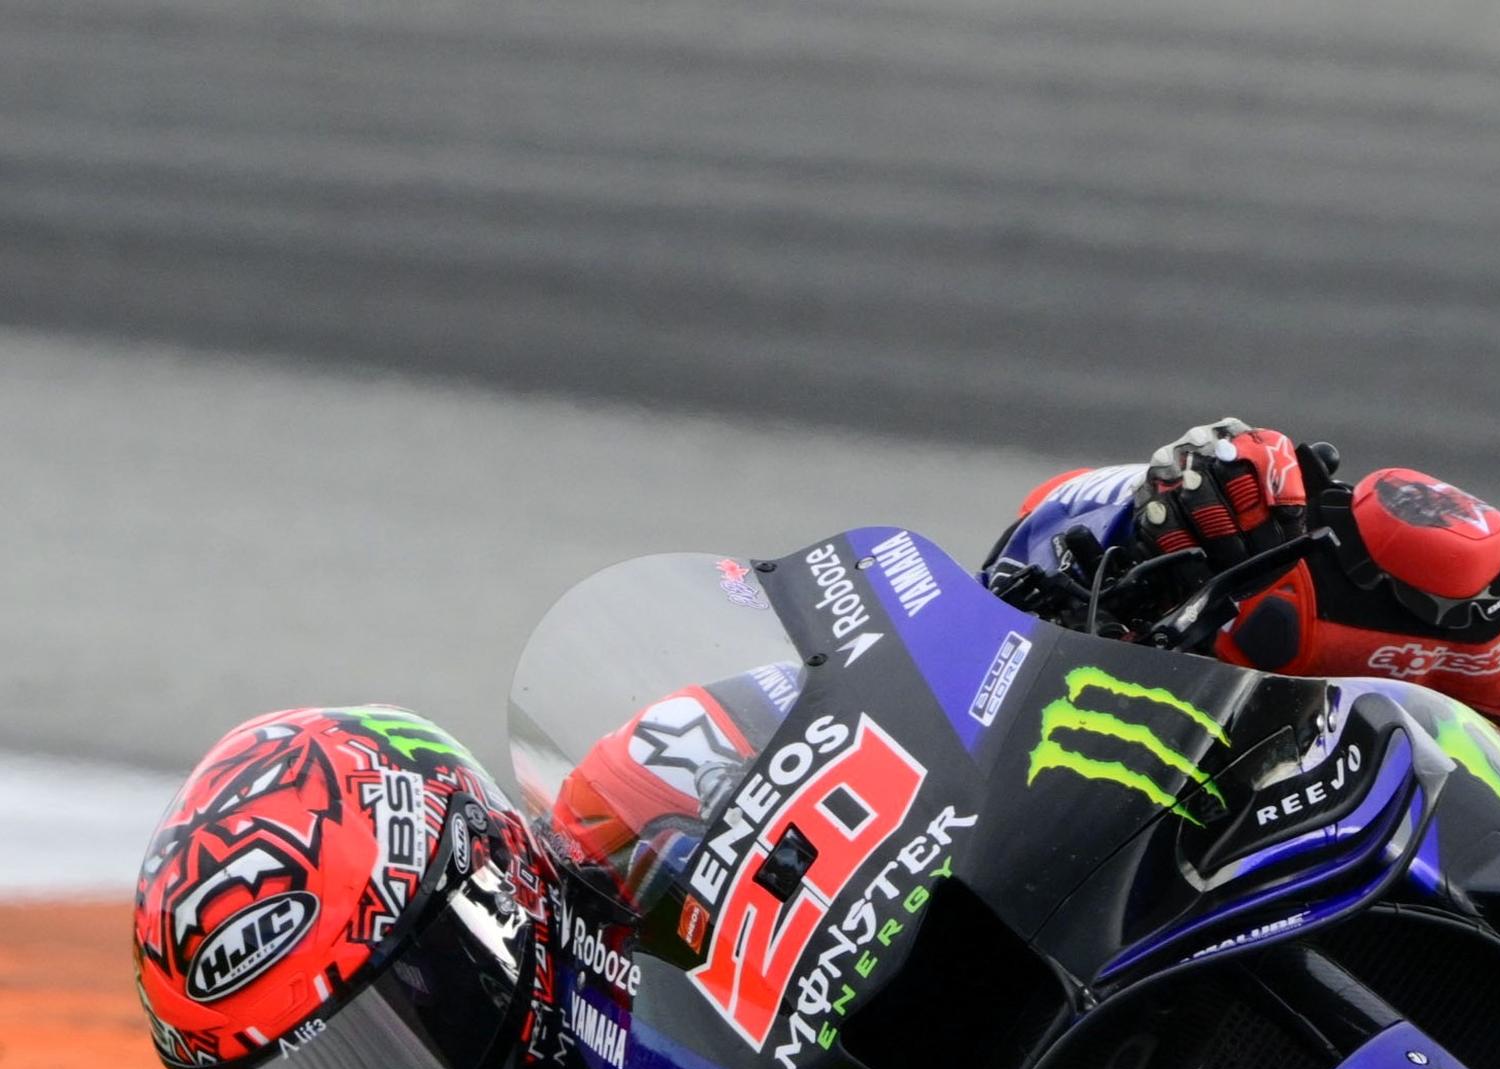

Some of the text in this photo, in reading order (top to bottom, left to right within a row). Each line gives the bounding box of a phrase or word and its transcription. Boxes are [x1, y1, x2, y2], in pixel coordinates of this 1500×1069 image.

[806, 544, 871, 639] Roboze
[871, 530, 941, 617] YAMAHA
[975, 641, 1015, 709] BLUE
[987, 647, 1025, 716] CORE
[690, 715, 849, 905] ENEOS
[1256, 744, 1361, 826] REEJO
[686, 711, 928, 1053] 20
[202, 898, 294, 991] HJC
[572, 917, 642, 997] Roboze
[816, 856, 953, 1051] ENERGY
